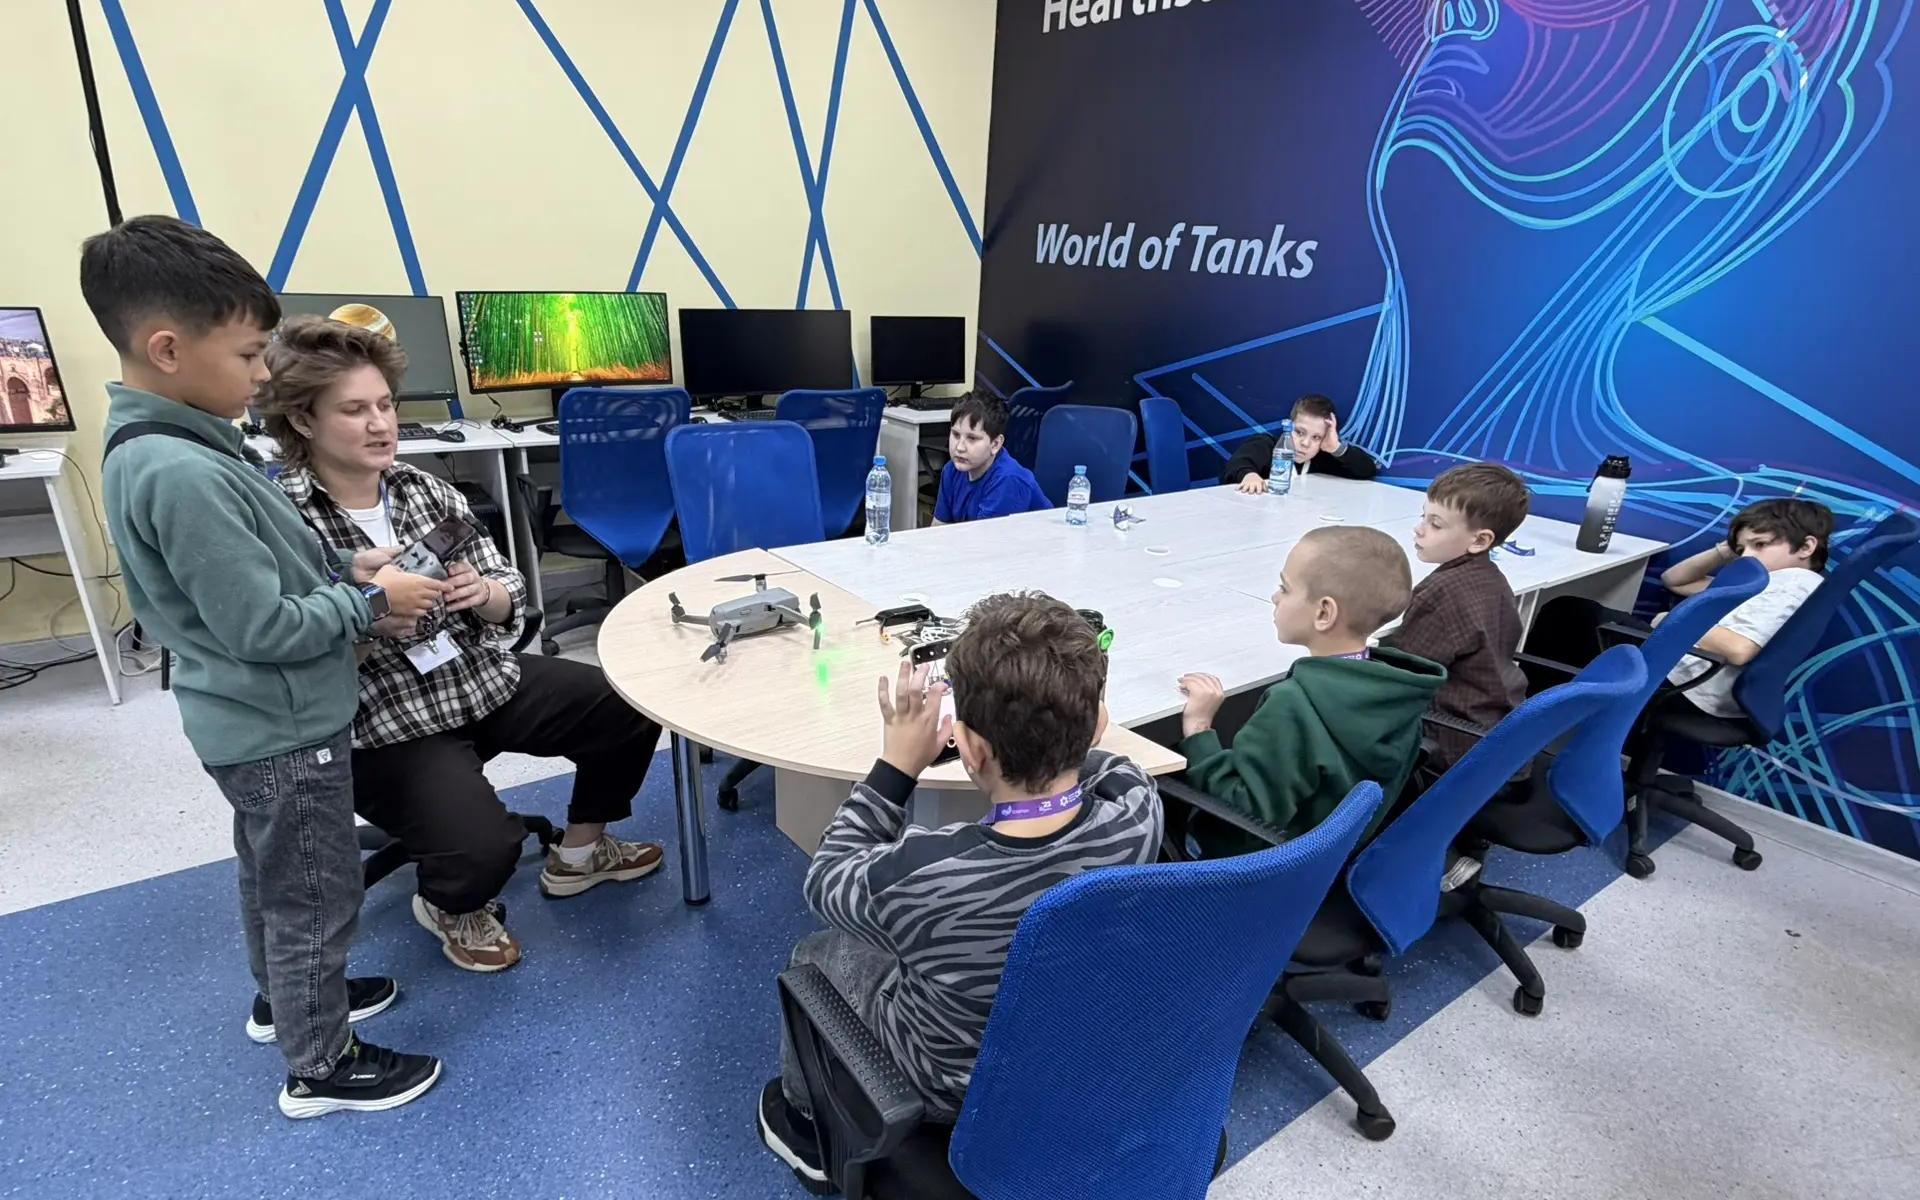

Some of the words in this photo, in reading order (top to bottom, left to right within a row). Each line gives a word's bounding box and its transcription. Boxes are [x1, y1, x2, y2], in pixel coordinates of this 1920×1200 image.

[1035, 222, 1135, 268] World
[1138, 222, 1186, 270] of
[1190, 224, 1318, 279] Tanks
